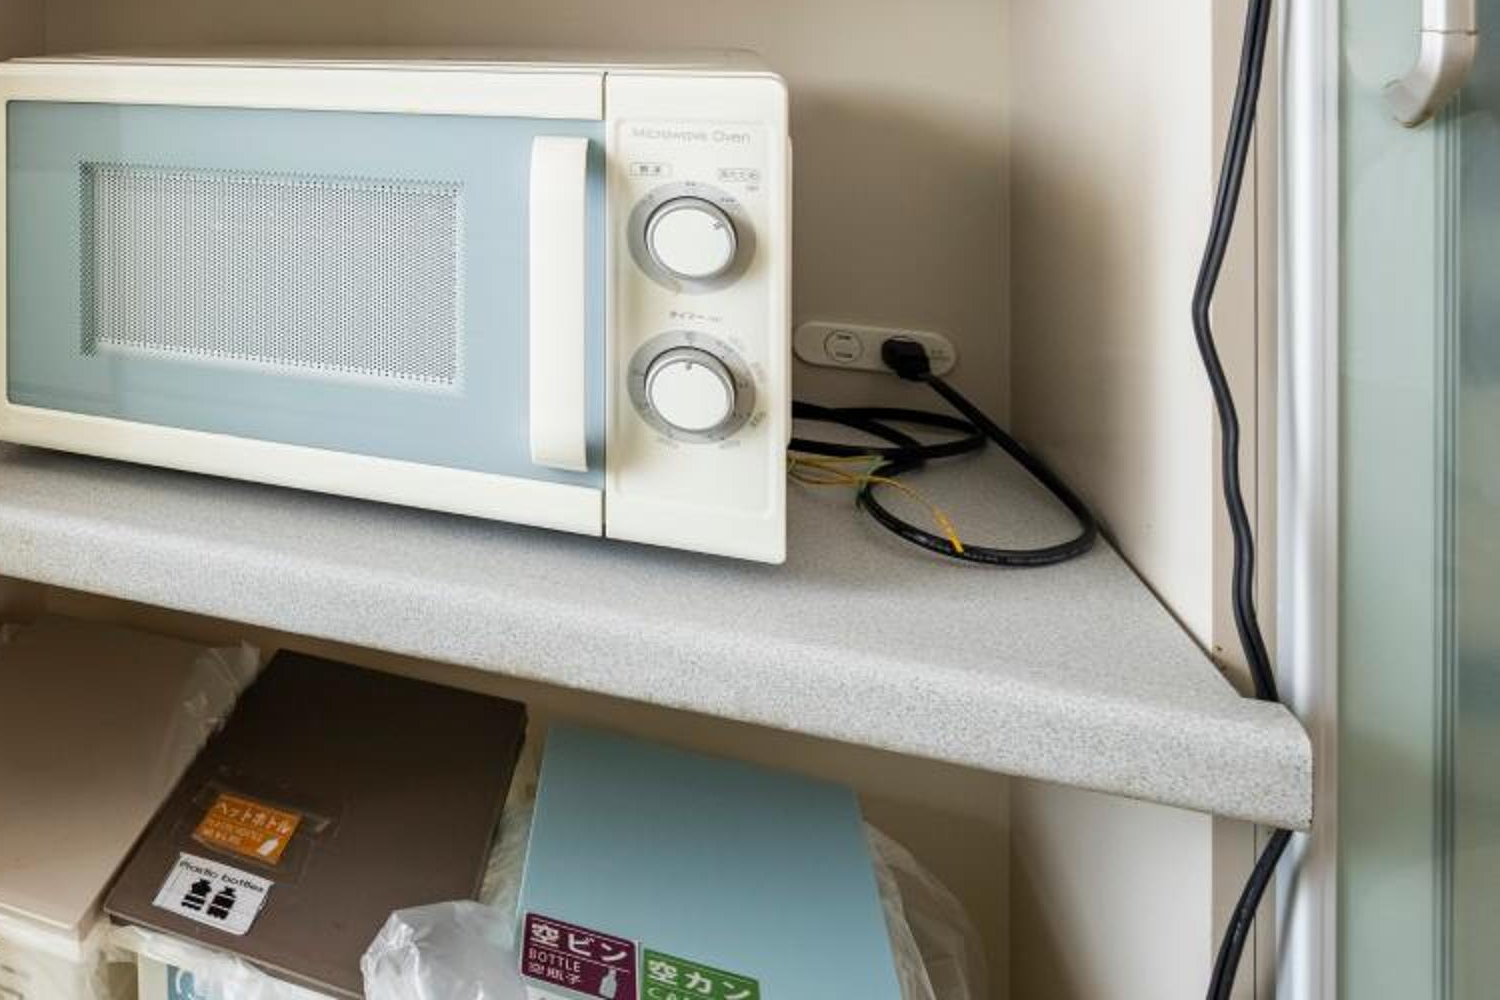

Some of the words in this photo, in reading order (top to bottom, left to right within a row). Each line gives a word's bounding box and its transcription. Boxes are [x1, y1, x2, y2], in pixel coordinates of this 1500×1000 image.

[631, 127, 709, 144] Microwave
[711, 129, 753, 146] Oven
[530, 923, 628, 962] 空ビン
[528, 947, 581, 973] BOTTLE
[647, 960, 752, 1000] 空カン
